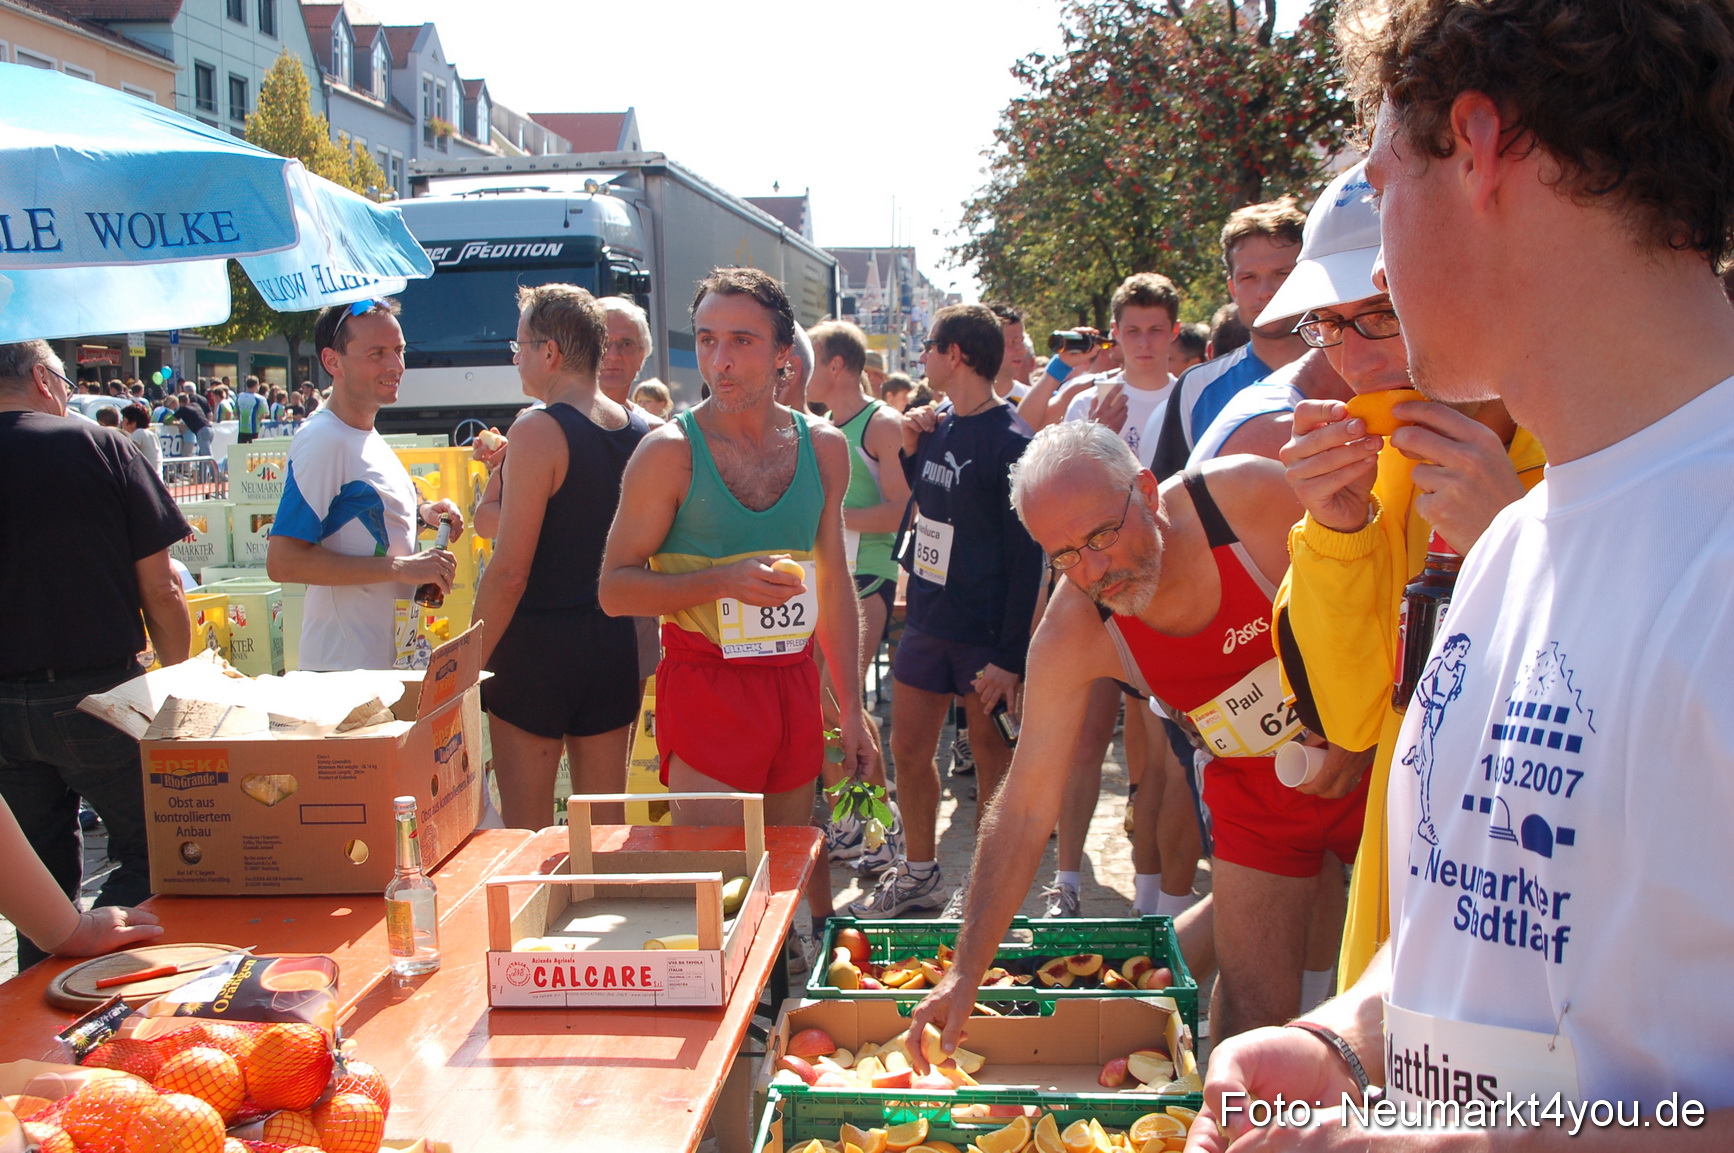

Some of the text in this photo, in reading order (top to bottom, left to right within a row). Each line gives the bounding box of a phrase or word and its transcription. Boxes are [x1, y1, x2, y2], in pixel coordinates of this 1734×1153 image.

[0, 208, 241, 253] LE WOLKE
[438, 242, 564, 265] SPEDITION
[922, 460, 953, 489] PUMA
[917, 542, 939, 565] 859
[760, 602, 805, 629] 832
[1233, 617, 1270, 646] asics
[1225, 682, 1264, 716] Paul
[1214, 738, 1227, 751] C
[149, 759, 229, 774] EDEKA
[169, 796, 215, 808] Obst aus
[154, 811, 231, 823] kontrolliertem
[176, 826, 212, 838] Anbau
[212, 959, 258, 1013] Orangen
[533, 965, 652, 988] CALCARE
